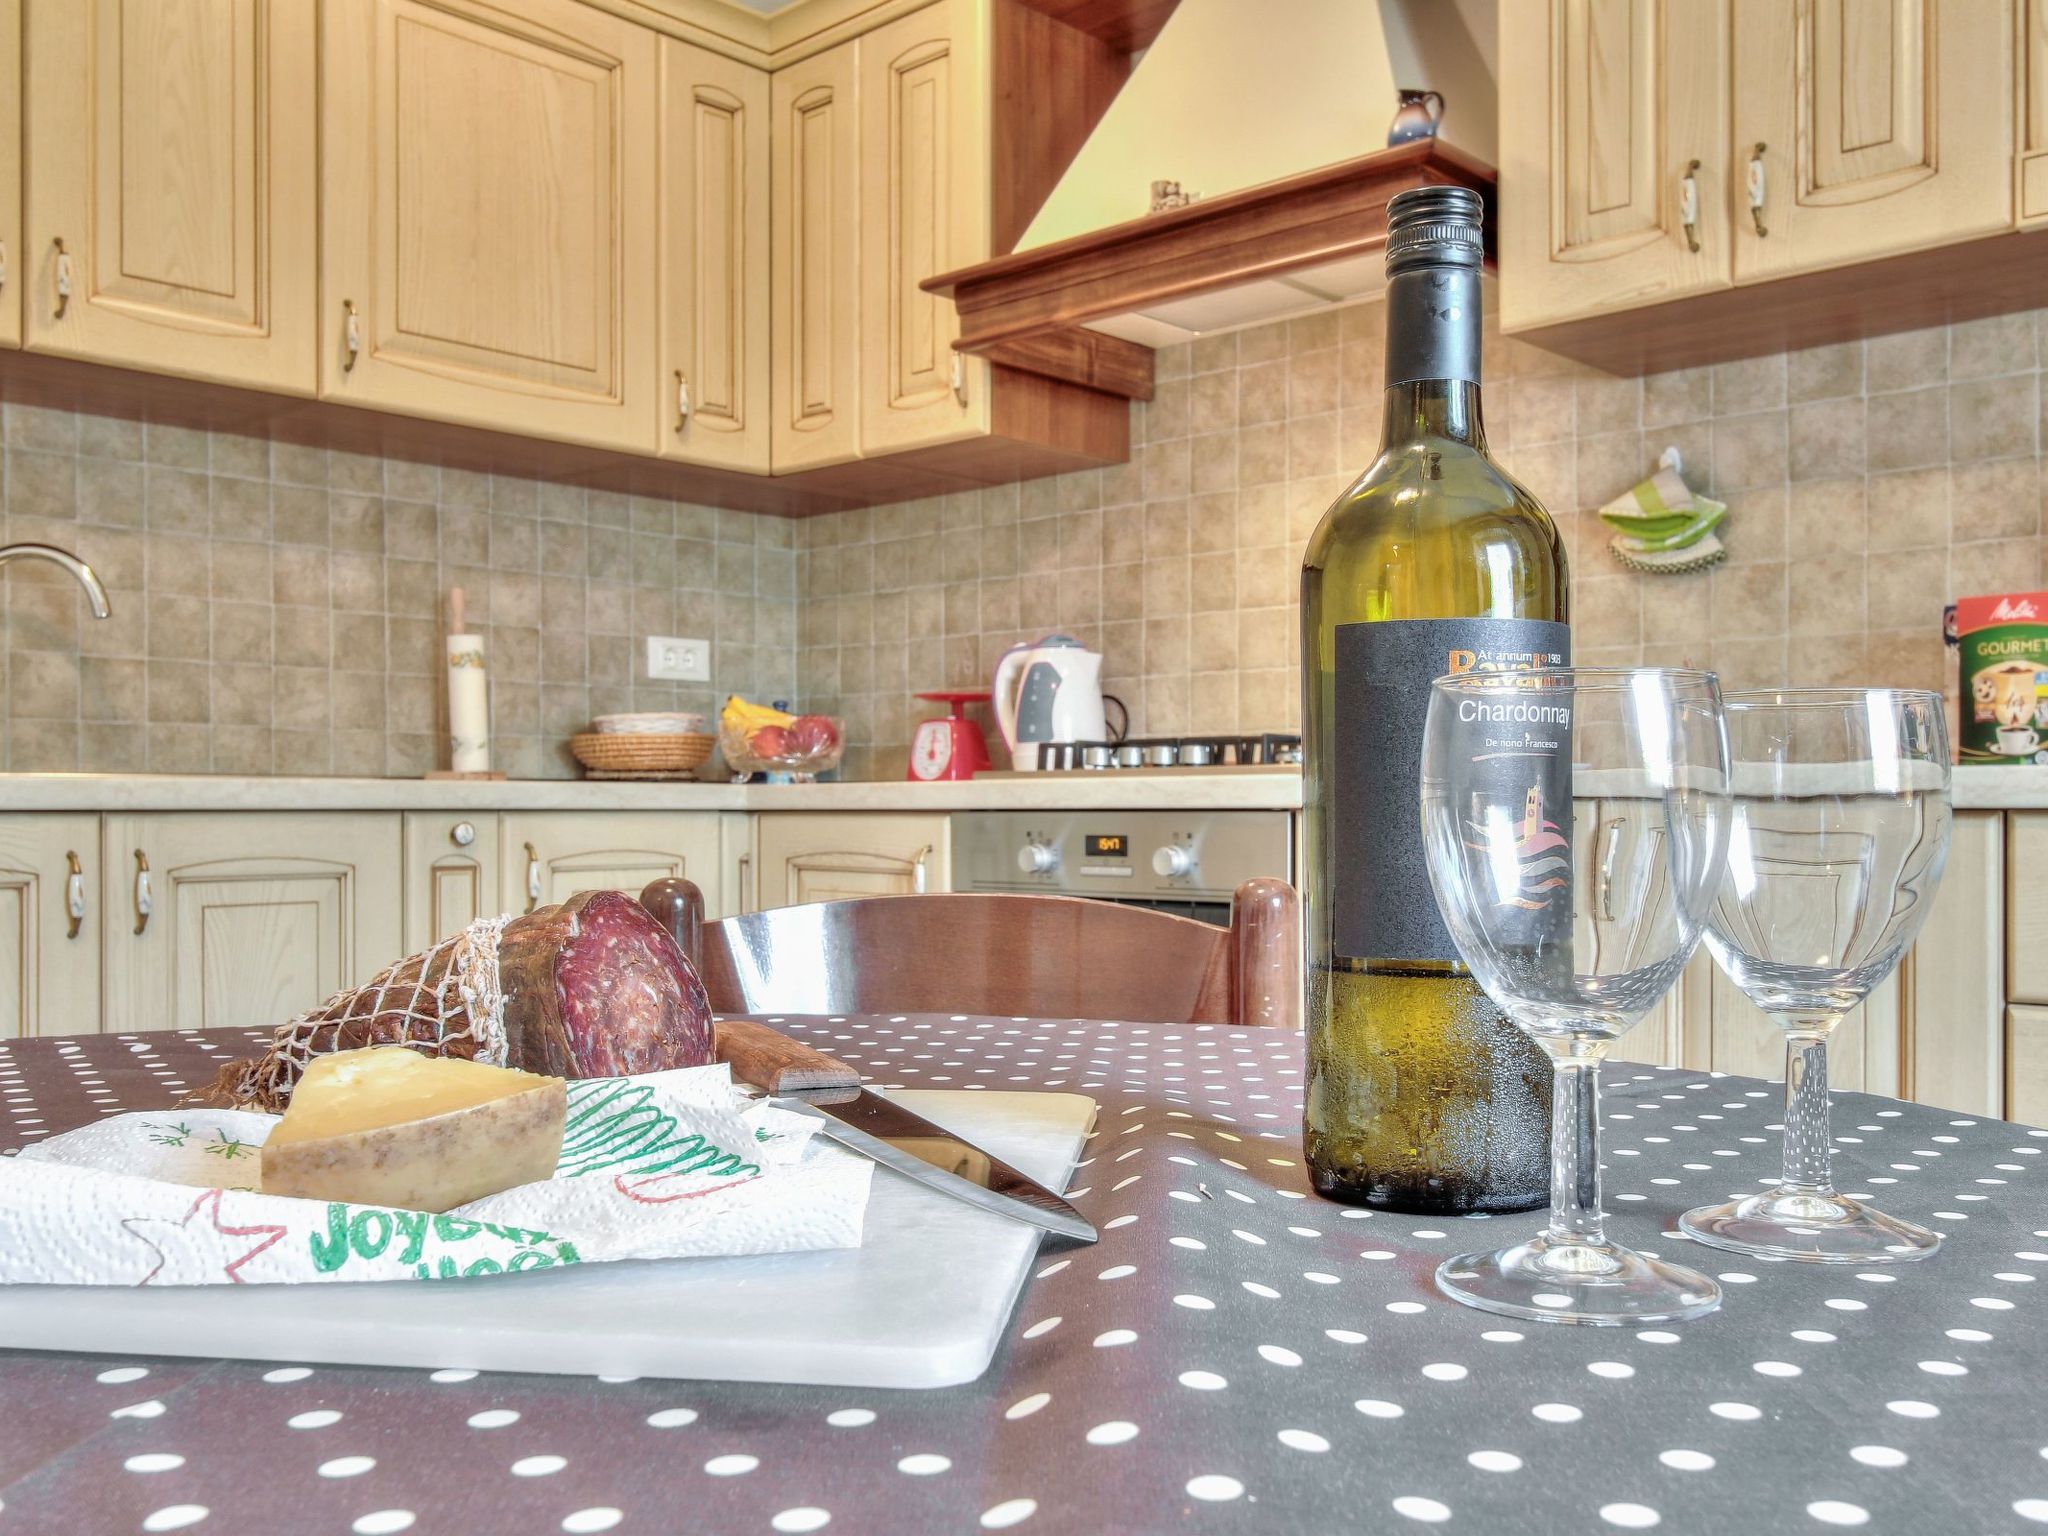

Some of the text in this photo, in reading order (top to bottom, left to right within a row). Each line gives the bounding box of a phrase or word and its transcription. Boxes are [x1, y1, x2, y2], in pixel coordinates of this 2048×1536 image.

[1496, 652, 1532, 662] annum
[1458, 700, 1570, 729] Chardonnay
[1485, 738, 1558, 749] De nono Francesco
